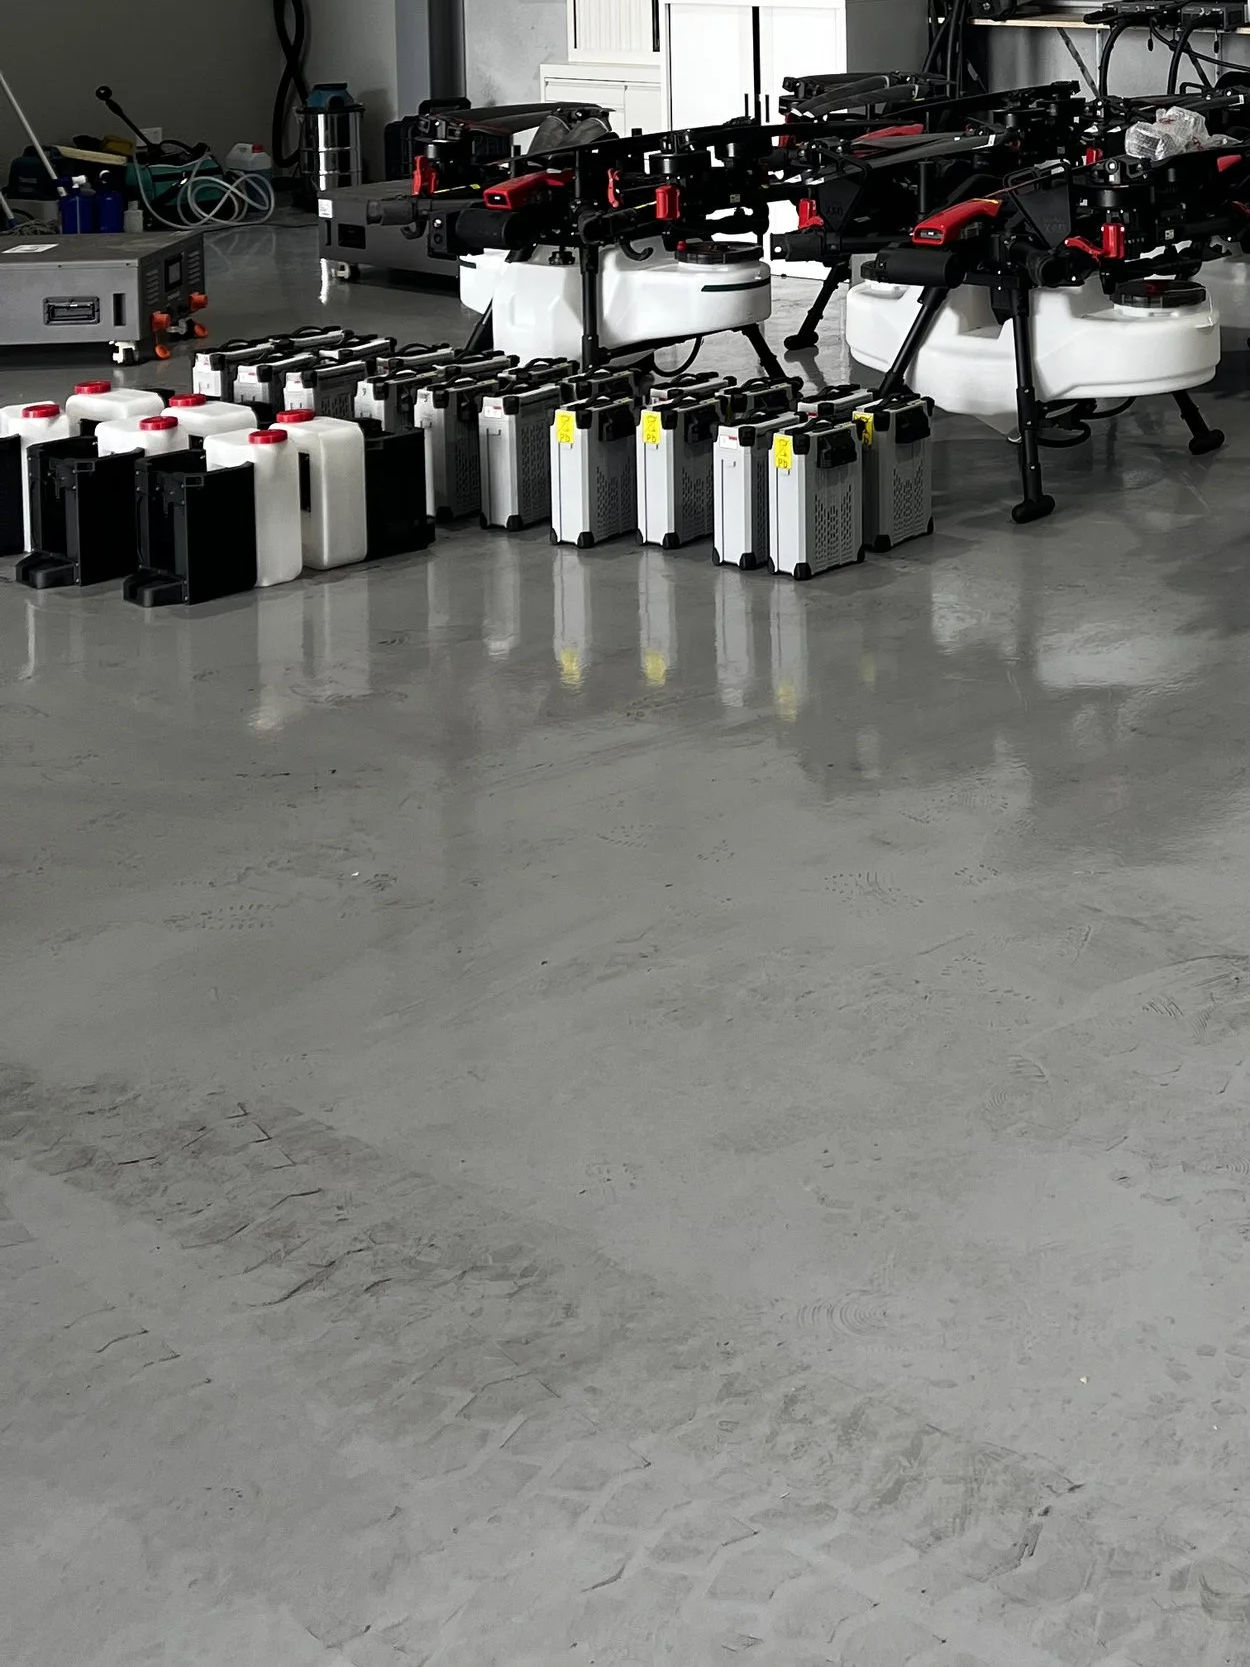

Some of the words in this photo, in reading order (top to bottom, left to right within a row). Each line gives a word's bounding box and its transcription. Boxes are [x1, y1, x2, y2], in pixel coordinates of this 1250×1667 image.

[560, 434, 571, 443] Pb
[646, 434, 657, 443] Pb
[778, 458, 788, 469] Pb
